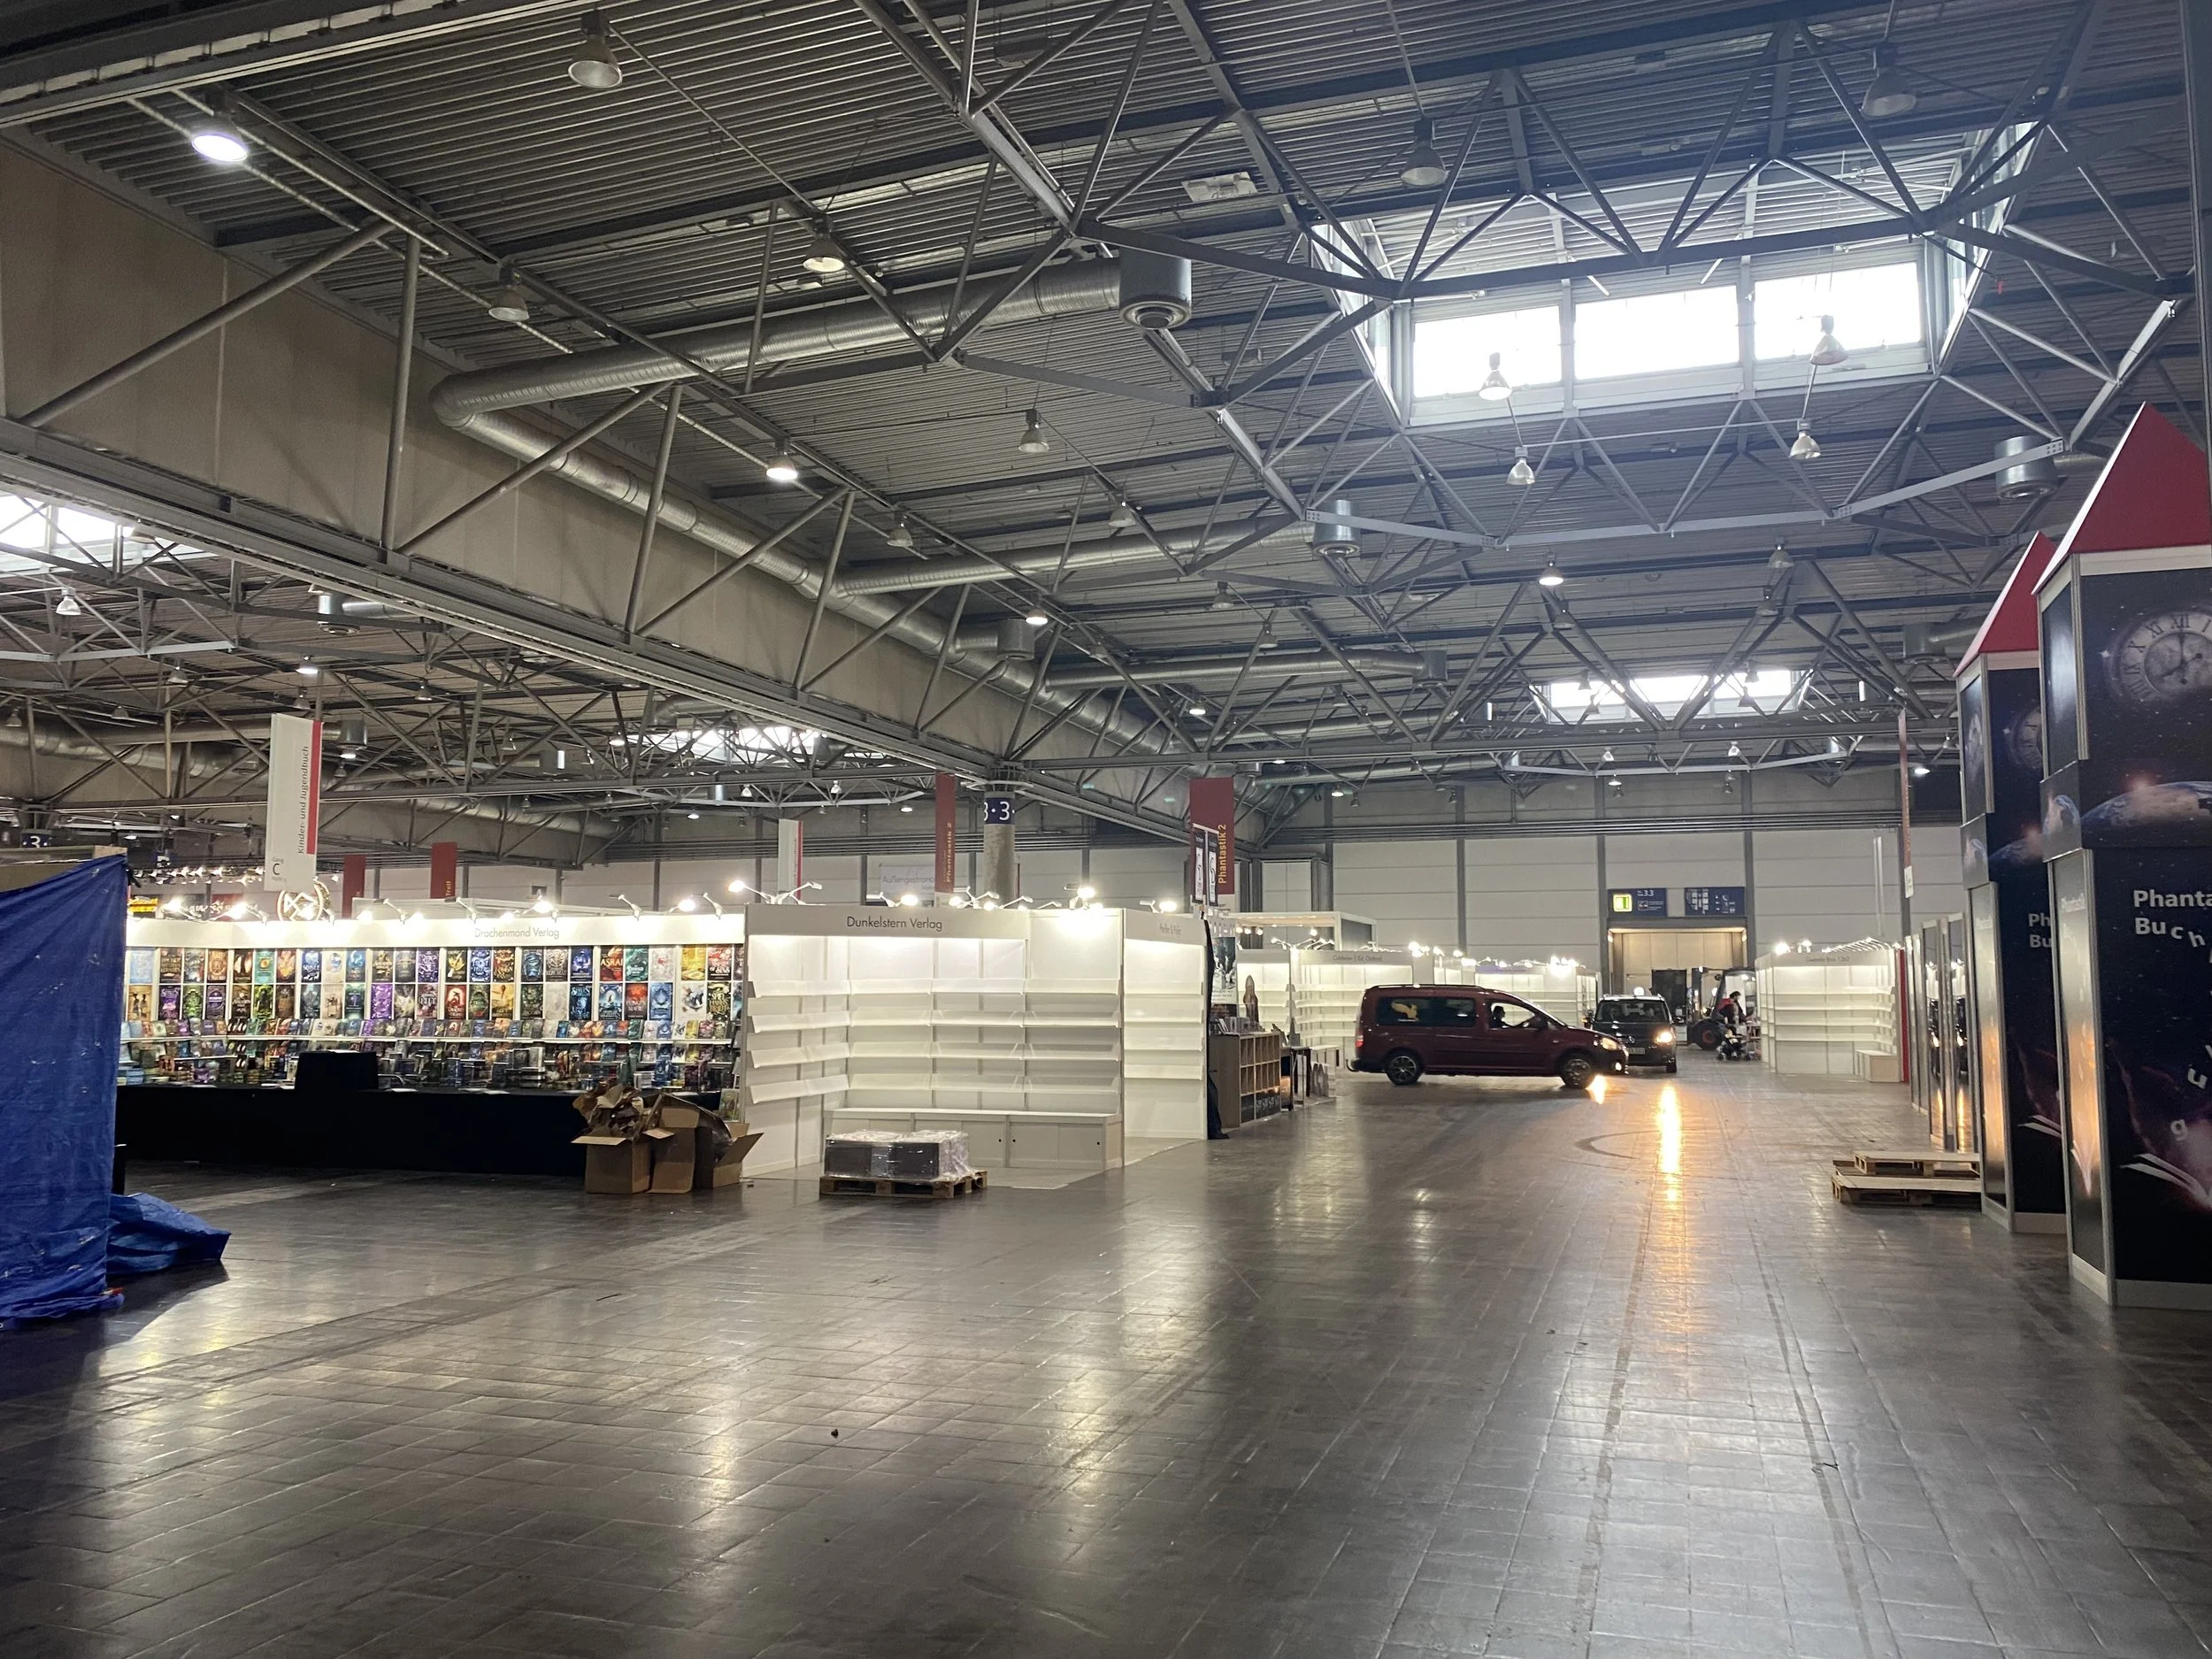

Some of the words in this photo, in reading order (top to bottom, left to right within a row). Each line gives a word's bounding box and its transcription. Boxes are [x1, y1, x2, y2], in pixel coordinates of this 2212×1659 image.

[300, 745, 310, 800] Jugendbuch
[297, 821, 306, 854] Kinder-
[273, 863, 280, 876] C
[1217, 833, 1227, 885] Phantastik
[474, 926, 531, 938] Drachenmond
[533, 926, 560, 940] Verlag
[847, 915, 908, 929] Dunkelstern
[909, 917, 943, 932] Verlag
